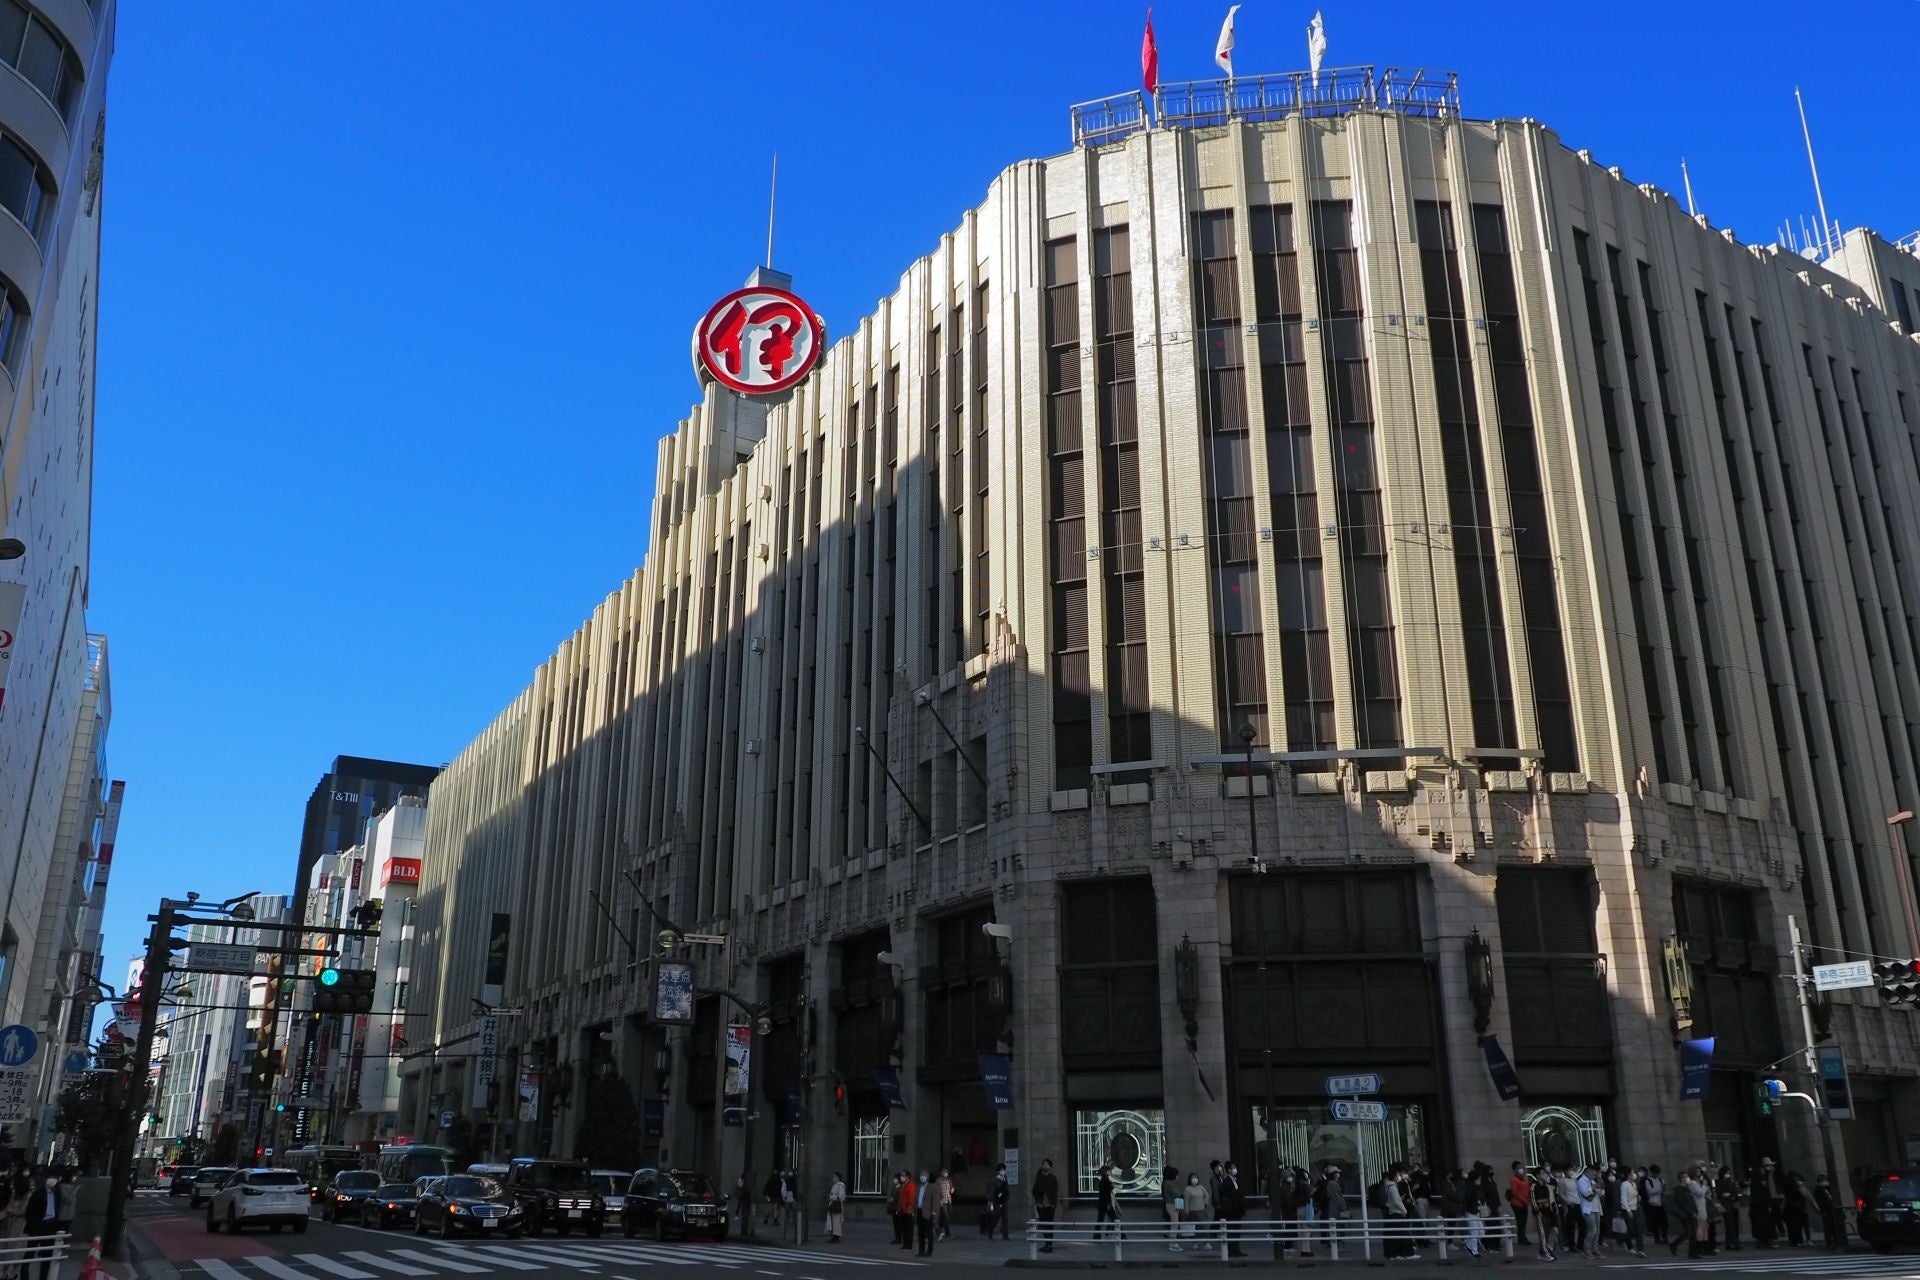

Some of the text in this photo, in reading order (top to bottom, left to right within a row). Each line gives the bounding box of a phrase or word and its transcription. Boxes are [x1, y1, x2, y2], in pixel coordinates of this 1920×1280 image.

[393, 865, 419, 879] BLD.
[1819, 965, 1867, 979] 新宿三丁目
[480, 1019, 496, 1085] 井住友銀行
